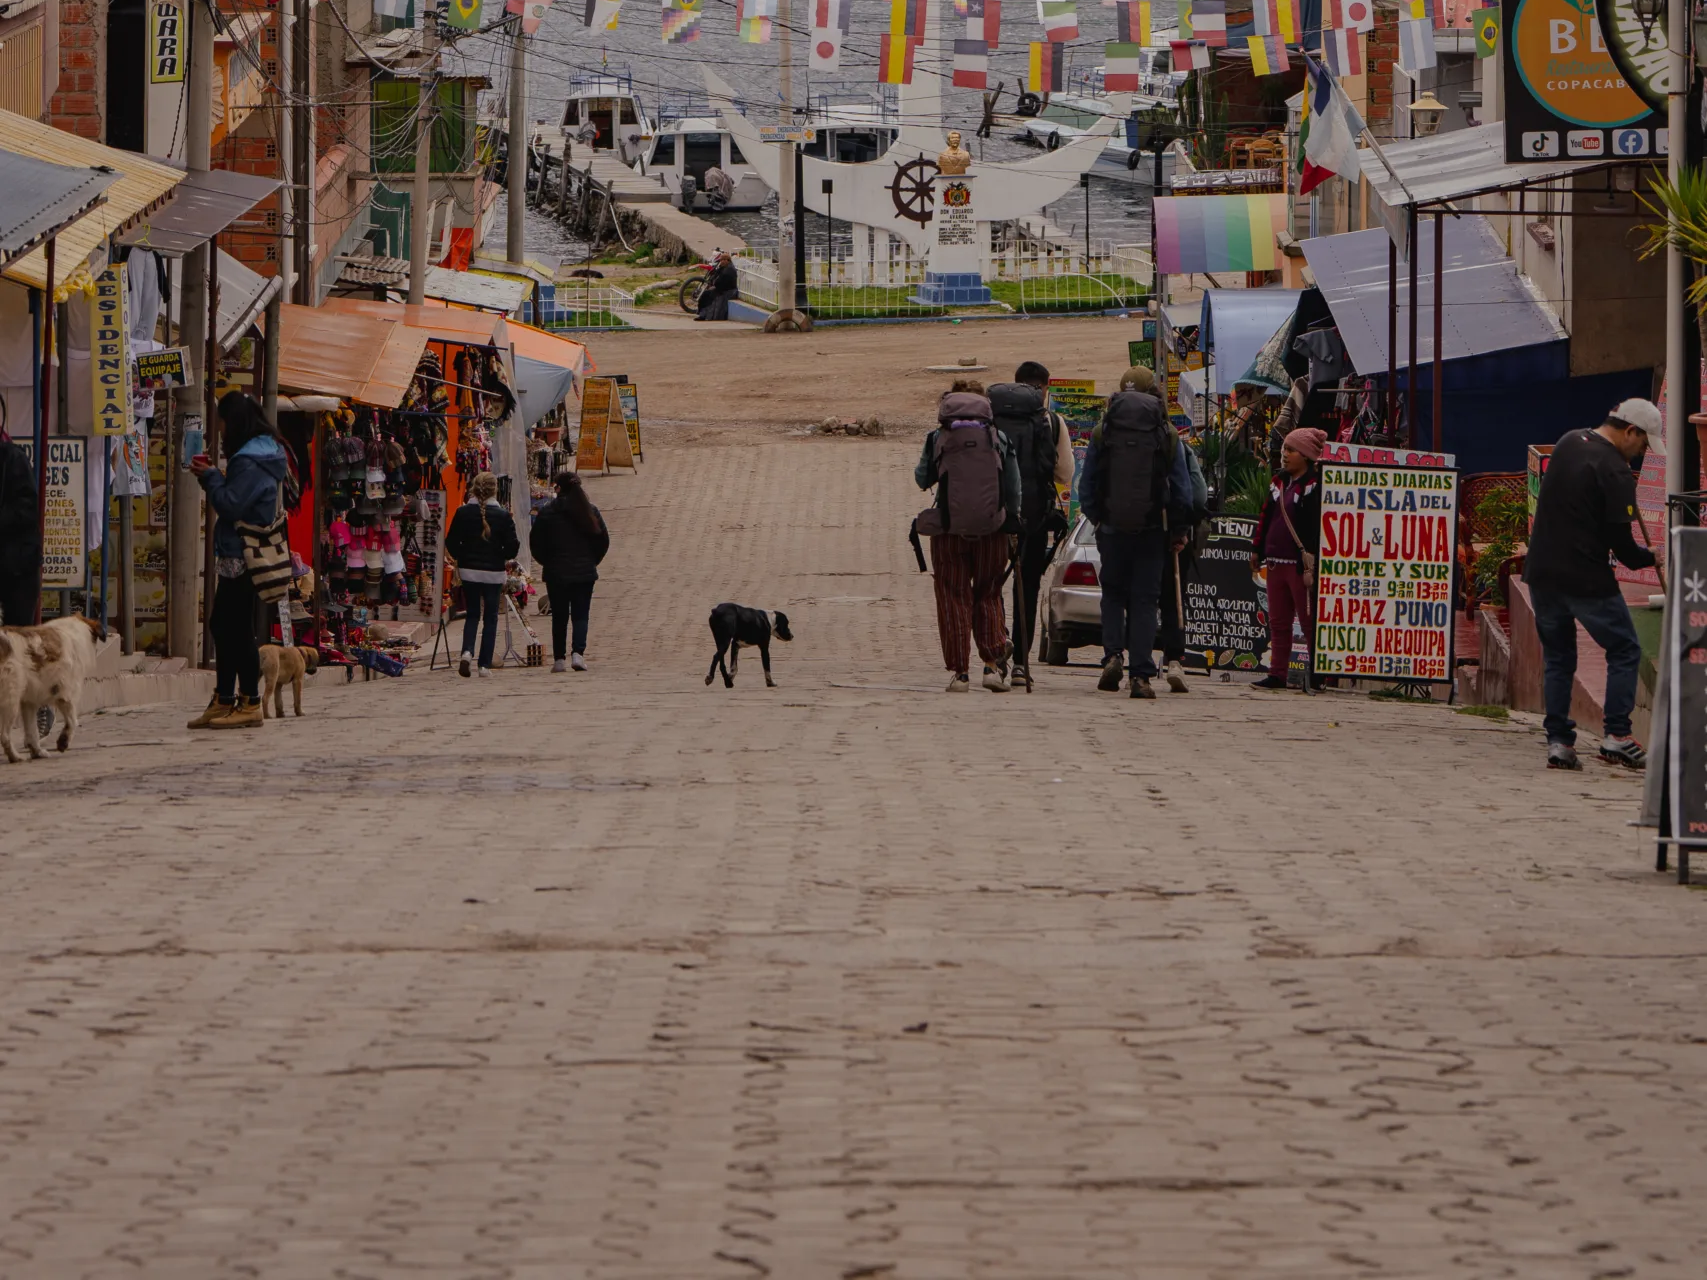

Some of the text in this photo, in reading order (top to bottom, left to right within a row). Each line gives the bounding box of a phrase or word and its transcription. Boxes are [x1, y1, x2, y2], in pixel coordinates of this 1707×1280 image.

[1546, 78, 1630, 91] COPACAB
[1571, 137, 1600, 149] YouTube
[95, 270, 123, 429] RESIDENCIAL
[139, 353, 180, 365] SE GUARDA
[140, 364, 182, 377] EQUIPAJE
[1358, 448, 1399, 465] DEL
[1405, 453, 1448, 467] SOL
[1324, 470, 1452, 489] SALIDAS DIARIAS
[47, 499, 74, 507] ONES
[1357, 488, 1417, 512] ISLA
[1420, 495, 1451, 509] DEL
[44, 509, 77, 517] ABLES
[46, 518, 80, 527] RIPLES
[1218, 521, 1254, 537] MENU
[1322, 511, 1449, 562] SOL & LUNA
[45, 547, 80, 555] LIENTE
[1320, 559, 1449, 580] NORTE Y SUR
[1319, 577, 1346, 595] Hrs
[1394, 600, 1448, 627] PUNO
[1220, 636, 1229, 648] DE
[1230, 637, 1253, 650] POLLO
[1317, 625, 1445, 657] CUSCO AREQUIPA
[1289, 661, 1305, 670] ING
[1316, 653, 1342, 671] Hrs
